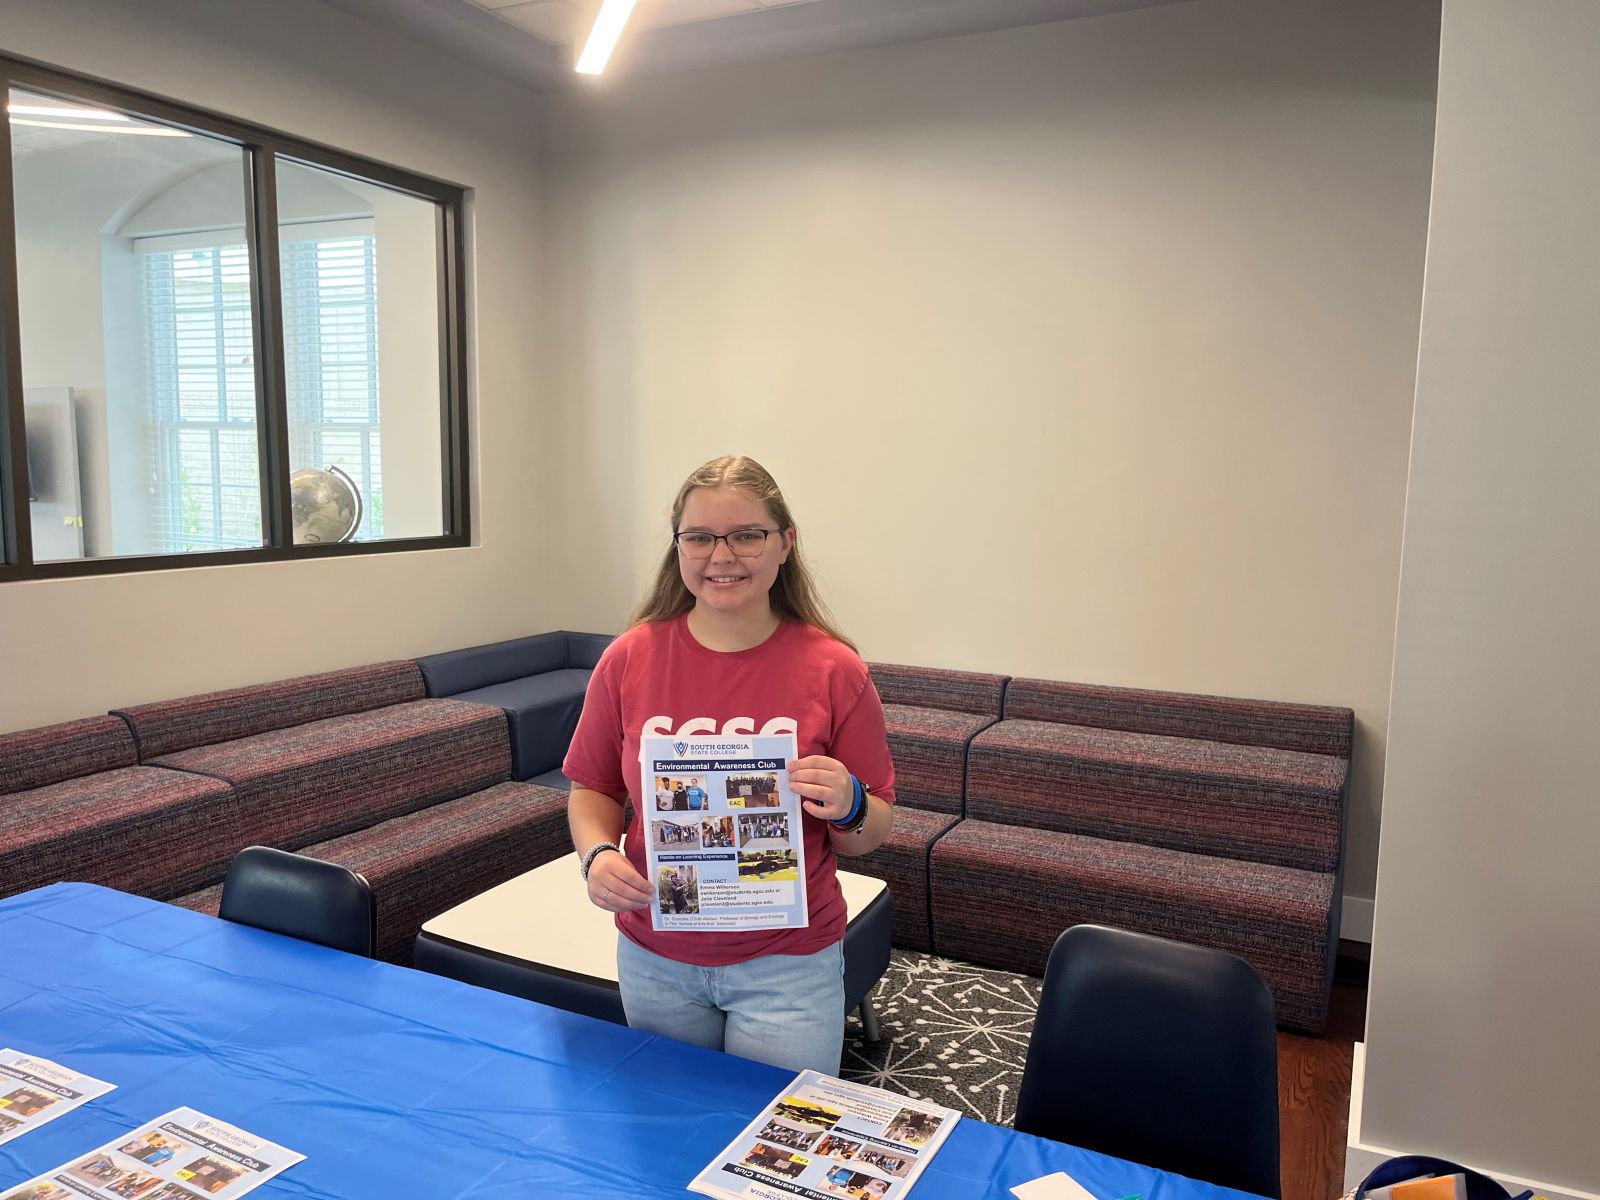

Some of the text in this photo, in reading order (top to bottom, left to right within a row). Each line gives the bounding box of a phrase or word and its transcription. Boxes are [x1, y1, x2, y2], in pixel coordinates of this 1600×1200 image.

[656, 760, 777, 771] Environmental Awareness Club
[733, 1166, 803, 1193] Awareness Club
